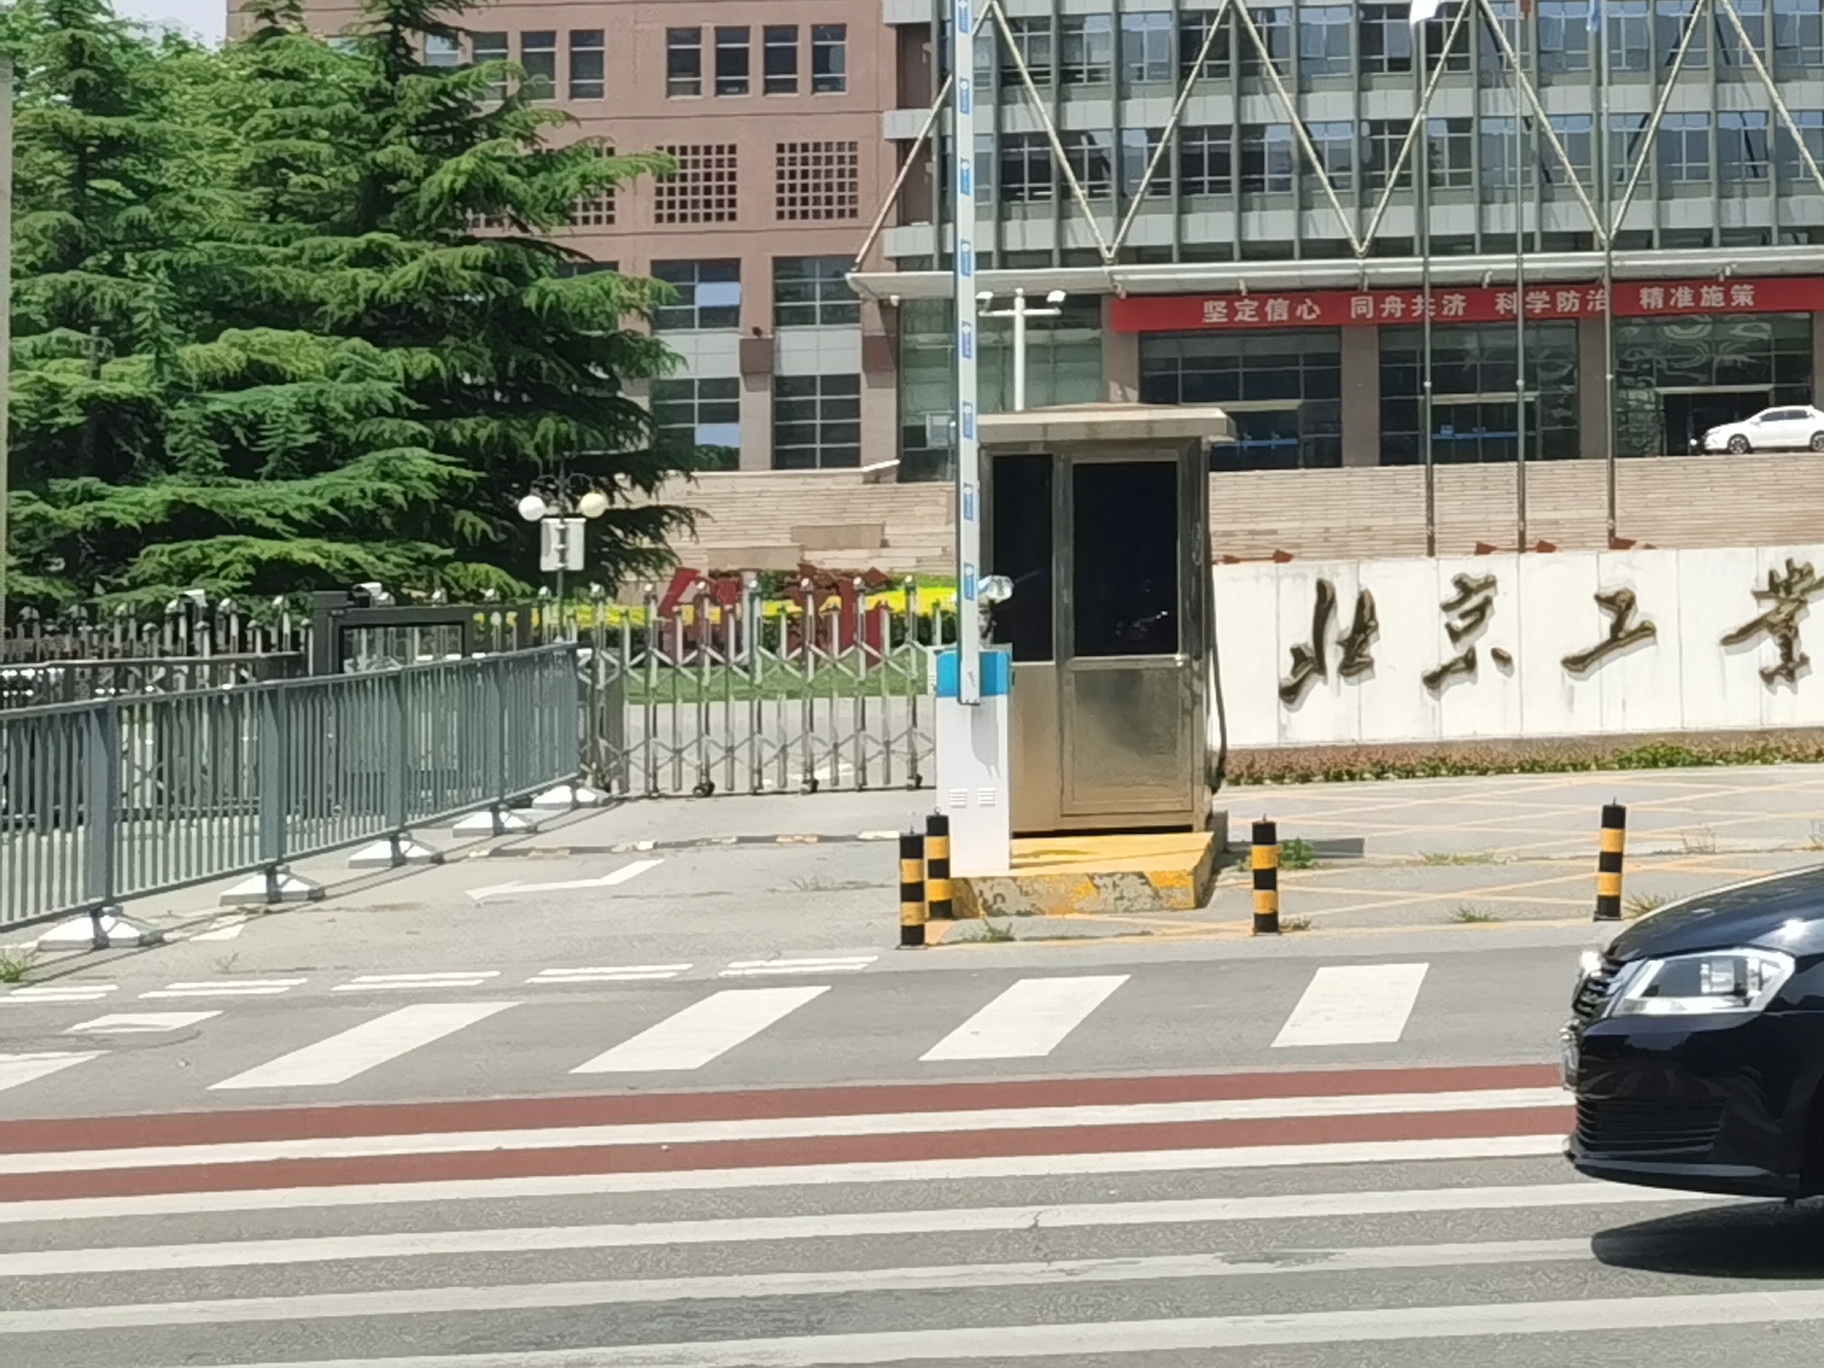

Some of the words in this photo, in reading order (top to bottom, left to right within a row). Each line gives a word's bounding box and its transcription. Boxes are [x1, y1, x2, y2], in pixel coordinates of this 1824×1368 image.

[1202, 298, 1321, 323] 坚定信心
[1350, 293, 1467, 319] 同舟共济
[1495, 289, 1609, 314] 科学防治
[1639, 284, 1755, 310] 精准施策
